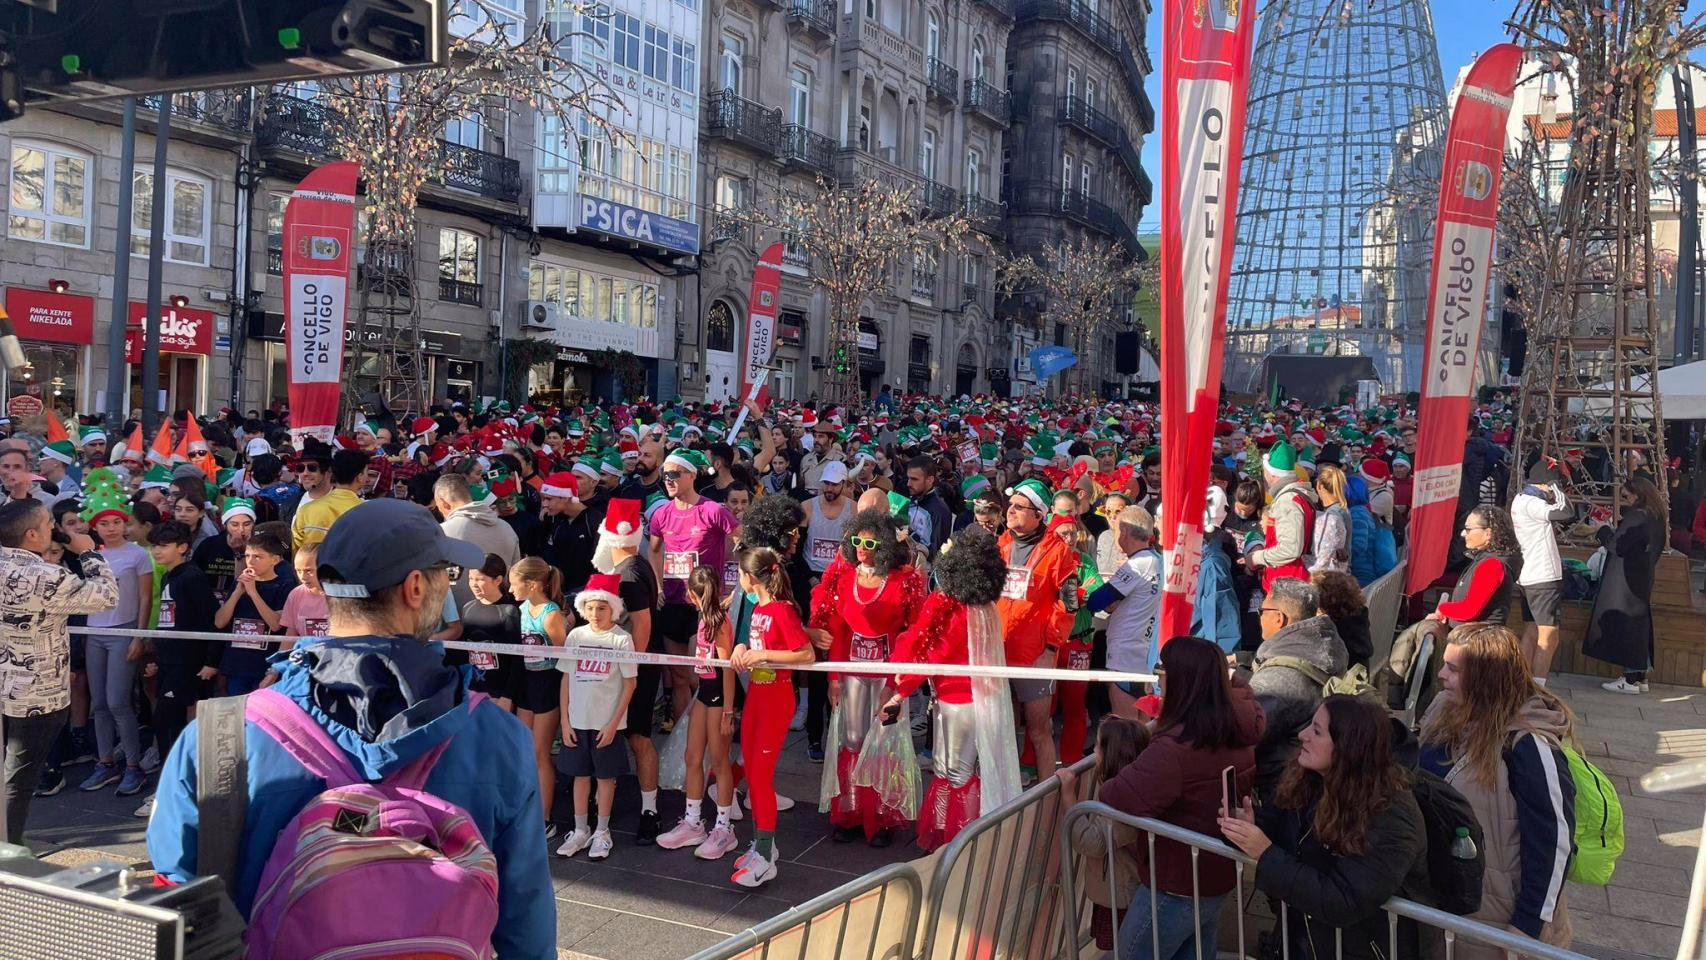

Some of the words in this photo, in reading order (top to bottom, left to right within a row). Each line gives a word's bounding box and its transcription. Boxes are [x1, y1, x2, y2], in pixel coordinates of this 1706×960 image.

[582, 198, 654, 241] PSICA
[1457, 256, 1475, 322] VIGO
[29, 306, 48, 315] PARA
[50, 309, 72, 318] XENTE
[29, 314, 73, 326] NIKELADA
[319, 294, 333, 335] VIGO
[303, 283, 318, 375] CONCELLO
[317, 342, 330, 363] DE
[749, 320, 763, 379] CONCELLO
[1453, 333, 1468, 366] DE
[456, 366, 463, 375] 9
[857, 646, 879, 659] 1977
